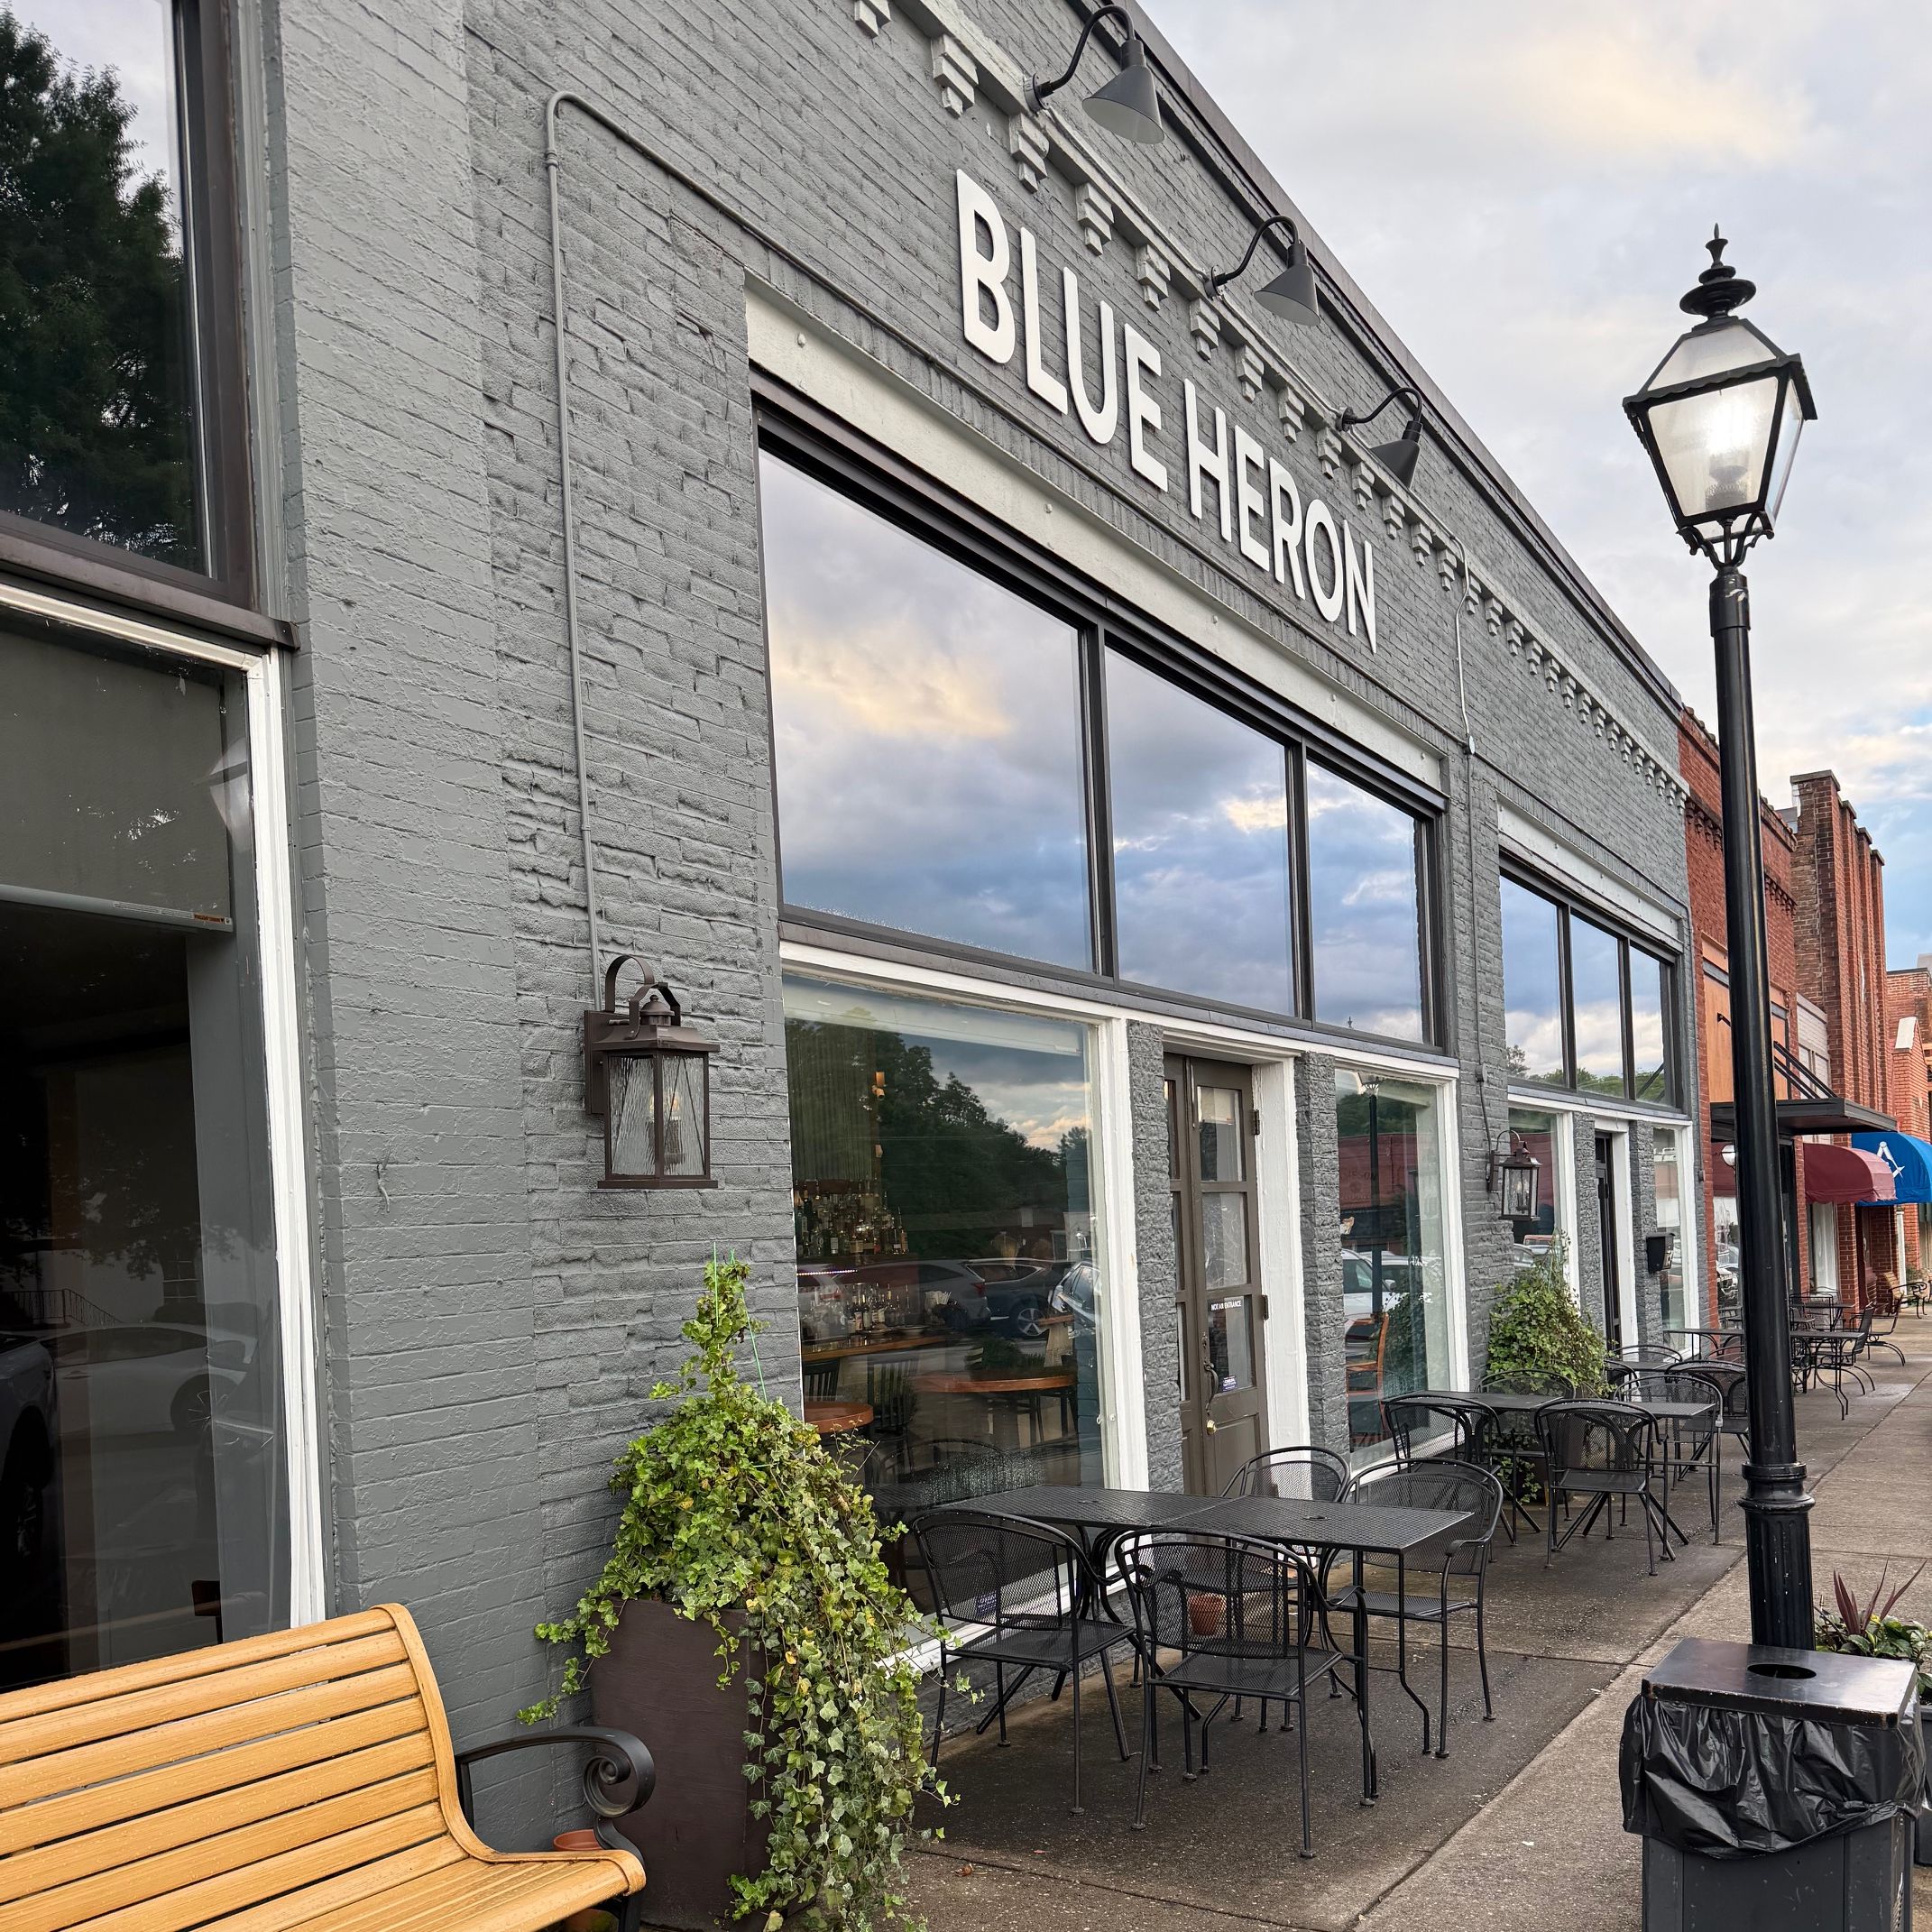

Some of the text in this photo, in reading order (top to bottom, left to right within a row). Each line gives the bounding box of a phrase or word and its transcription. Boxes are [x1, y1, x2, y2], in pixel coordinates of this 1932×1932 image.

[956, 170, 1376, 654] BLUE HERON
[1224, 1300, 1242, 1309] ENTRANCE
